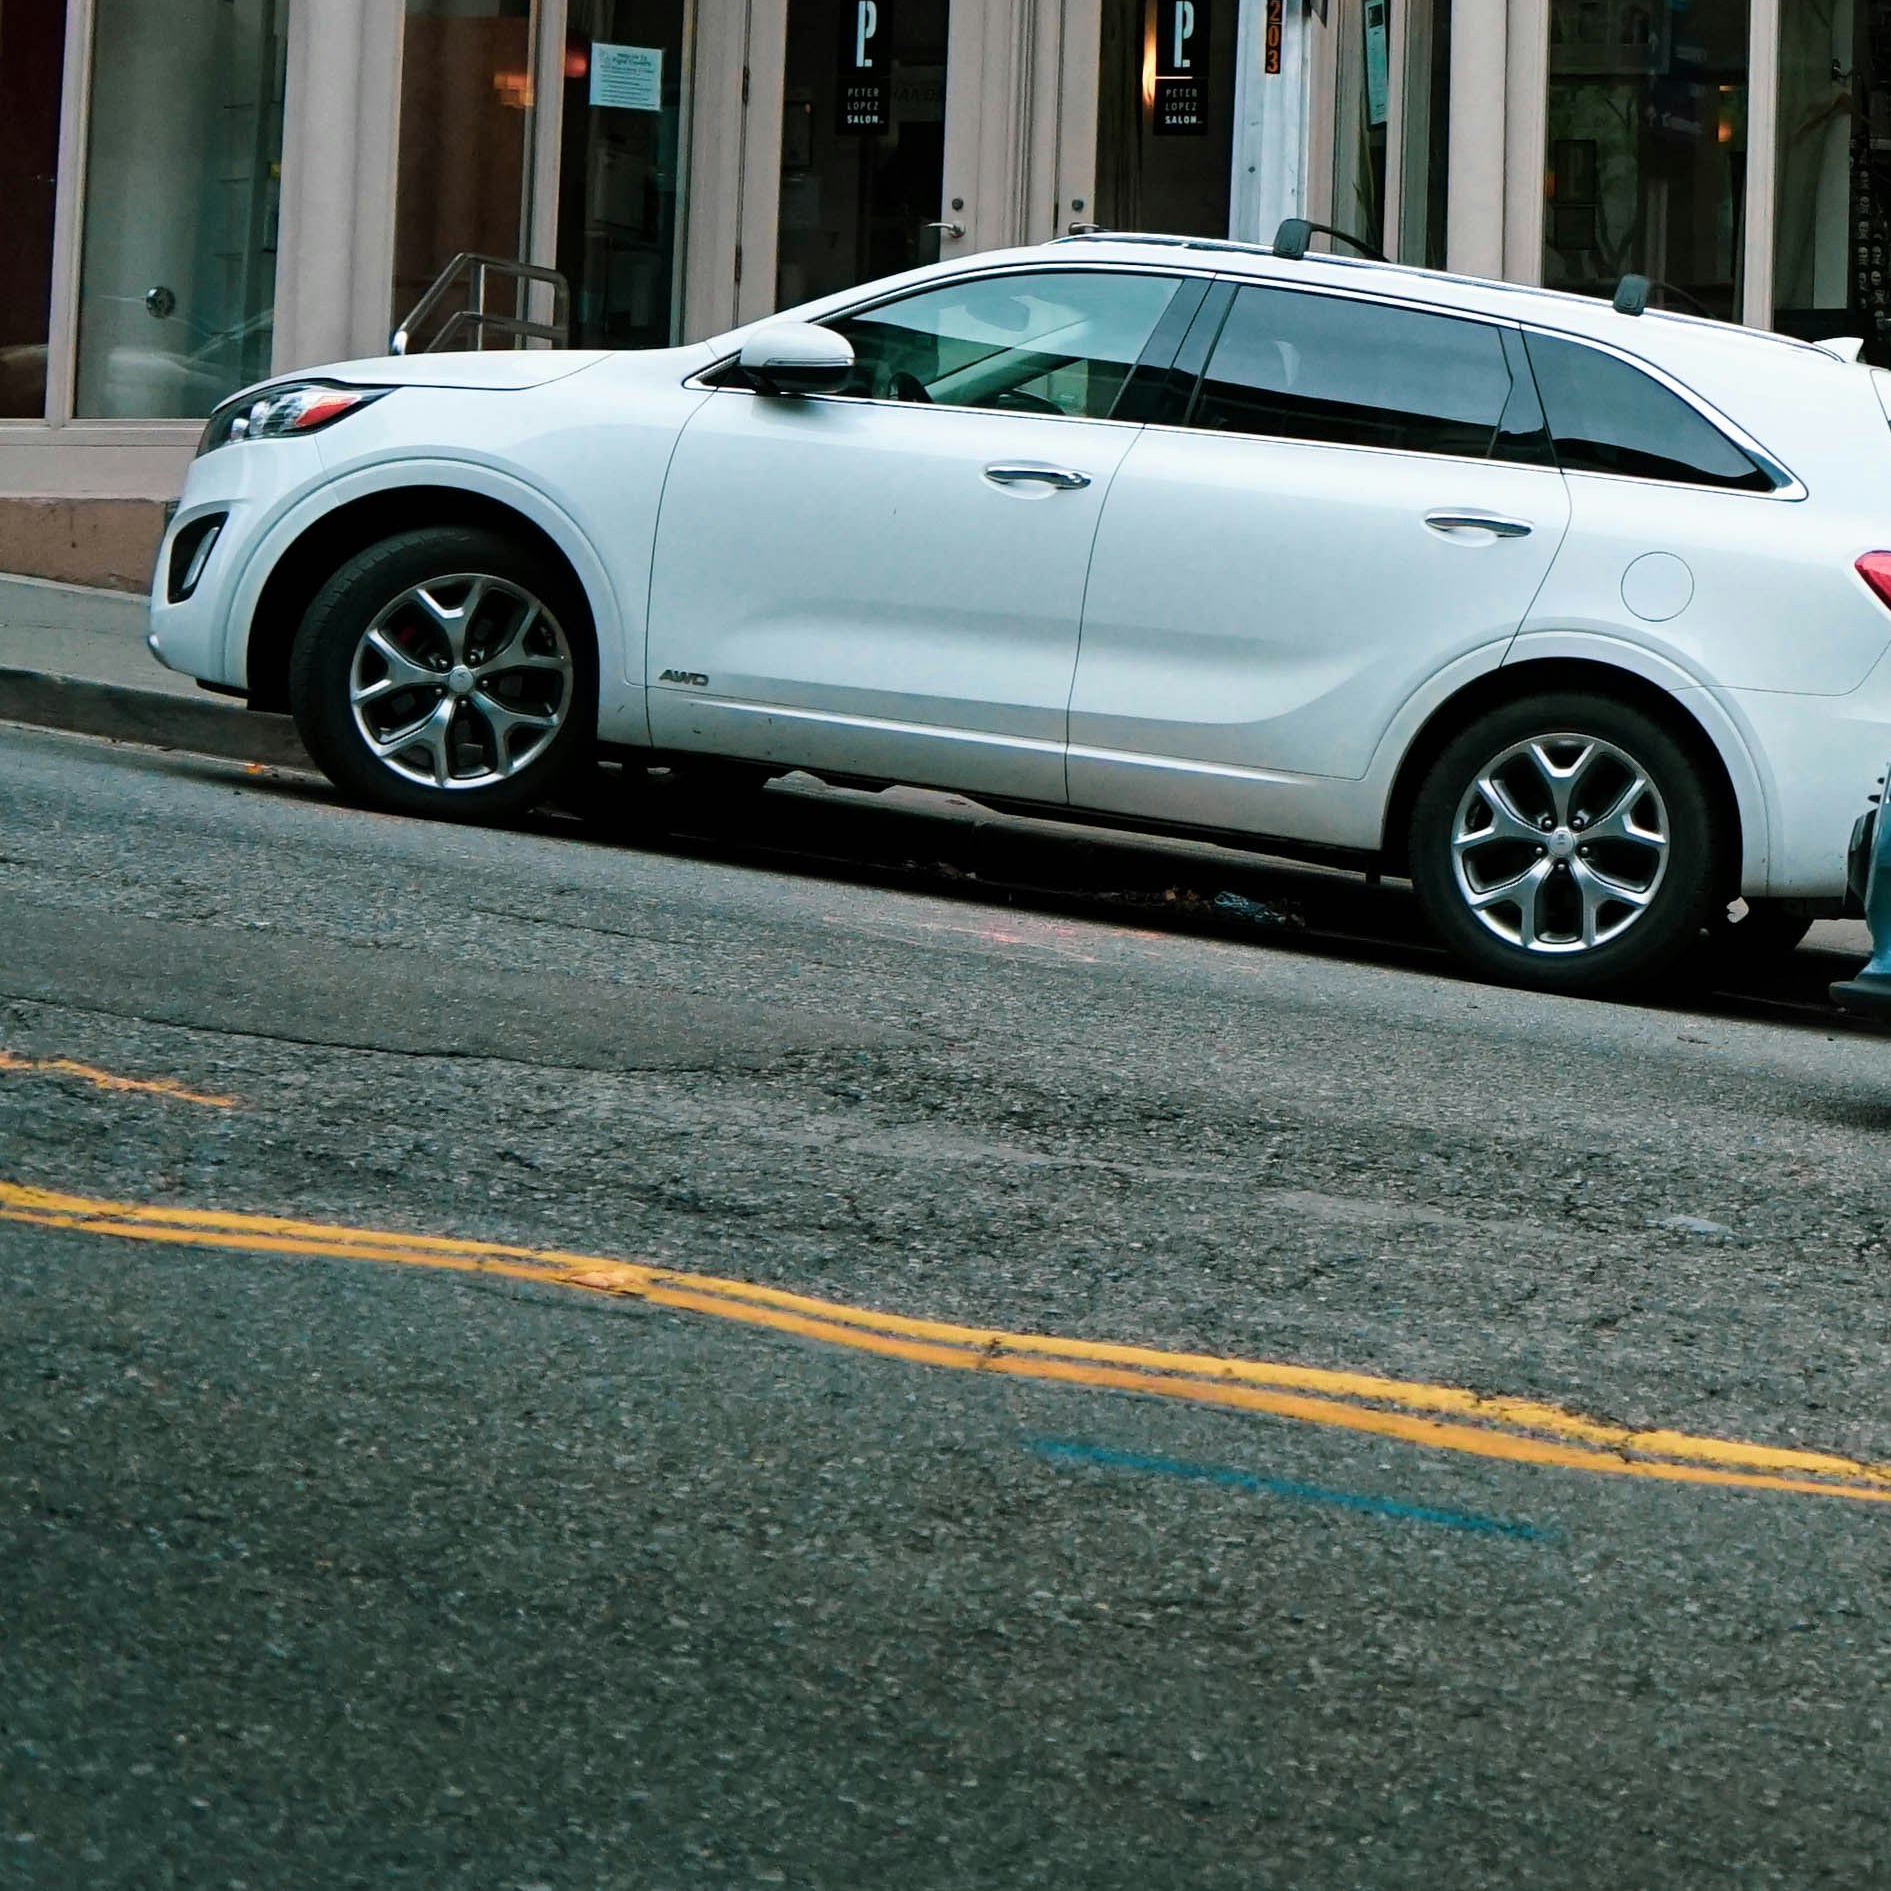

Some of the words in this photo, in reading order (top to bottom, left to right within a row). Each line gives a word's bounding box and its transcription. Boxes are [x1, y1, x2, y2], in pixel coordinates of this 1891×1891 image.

[1267, 0, 1282, 73] 203
[847, 88, 879, 98] PETER
[1165, 89, 1197, 99] PETER
[847, 101, 879, 111] LOPEZ
[1165, 102, 1197, 112] LOPEZ
[658, 669, 710, 687] AWD
